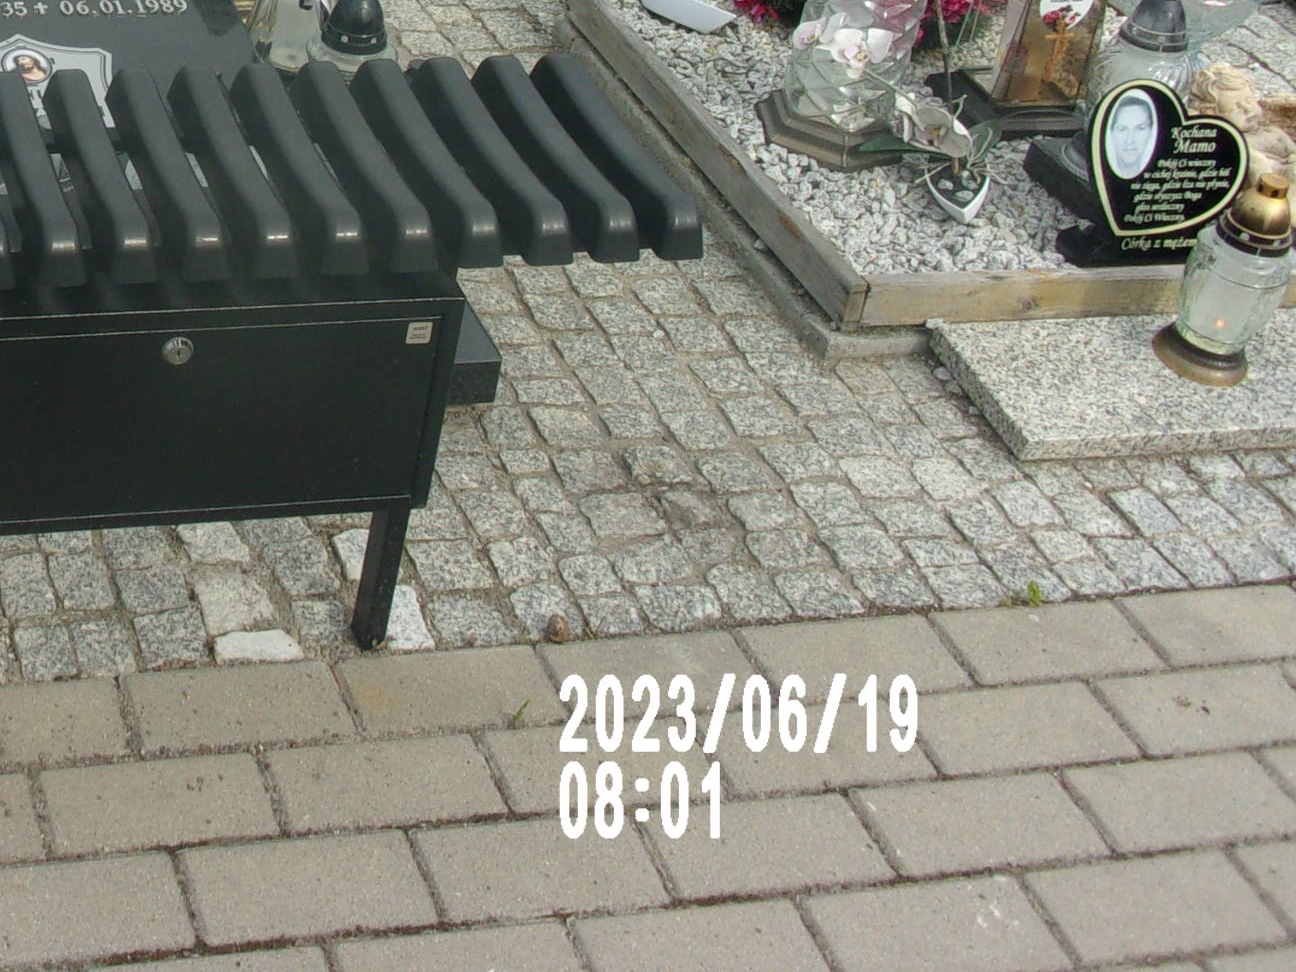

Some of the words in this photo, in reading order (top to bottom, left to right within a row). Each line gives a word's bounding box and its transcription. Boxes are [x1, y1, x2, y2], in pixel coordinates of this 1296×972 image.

[1171, 125, 1218, 139] Kochana
[1173, 139, 1217, 154] Mamo
[1121, 236, 1152, 251] Córka
[1154, 239, 1162, 249] z
[1163, 238, 1198, 250] mężem
